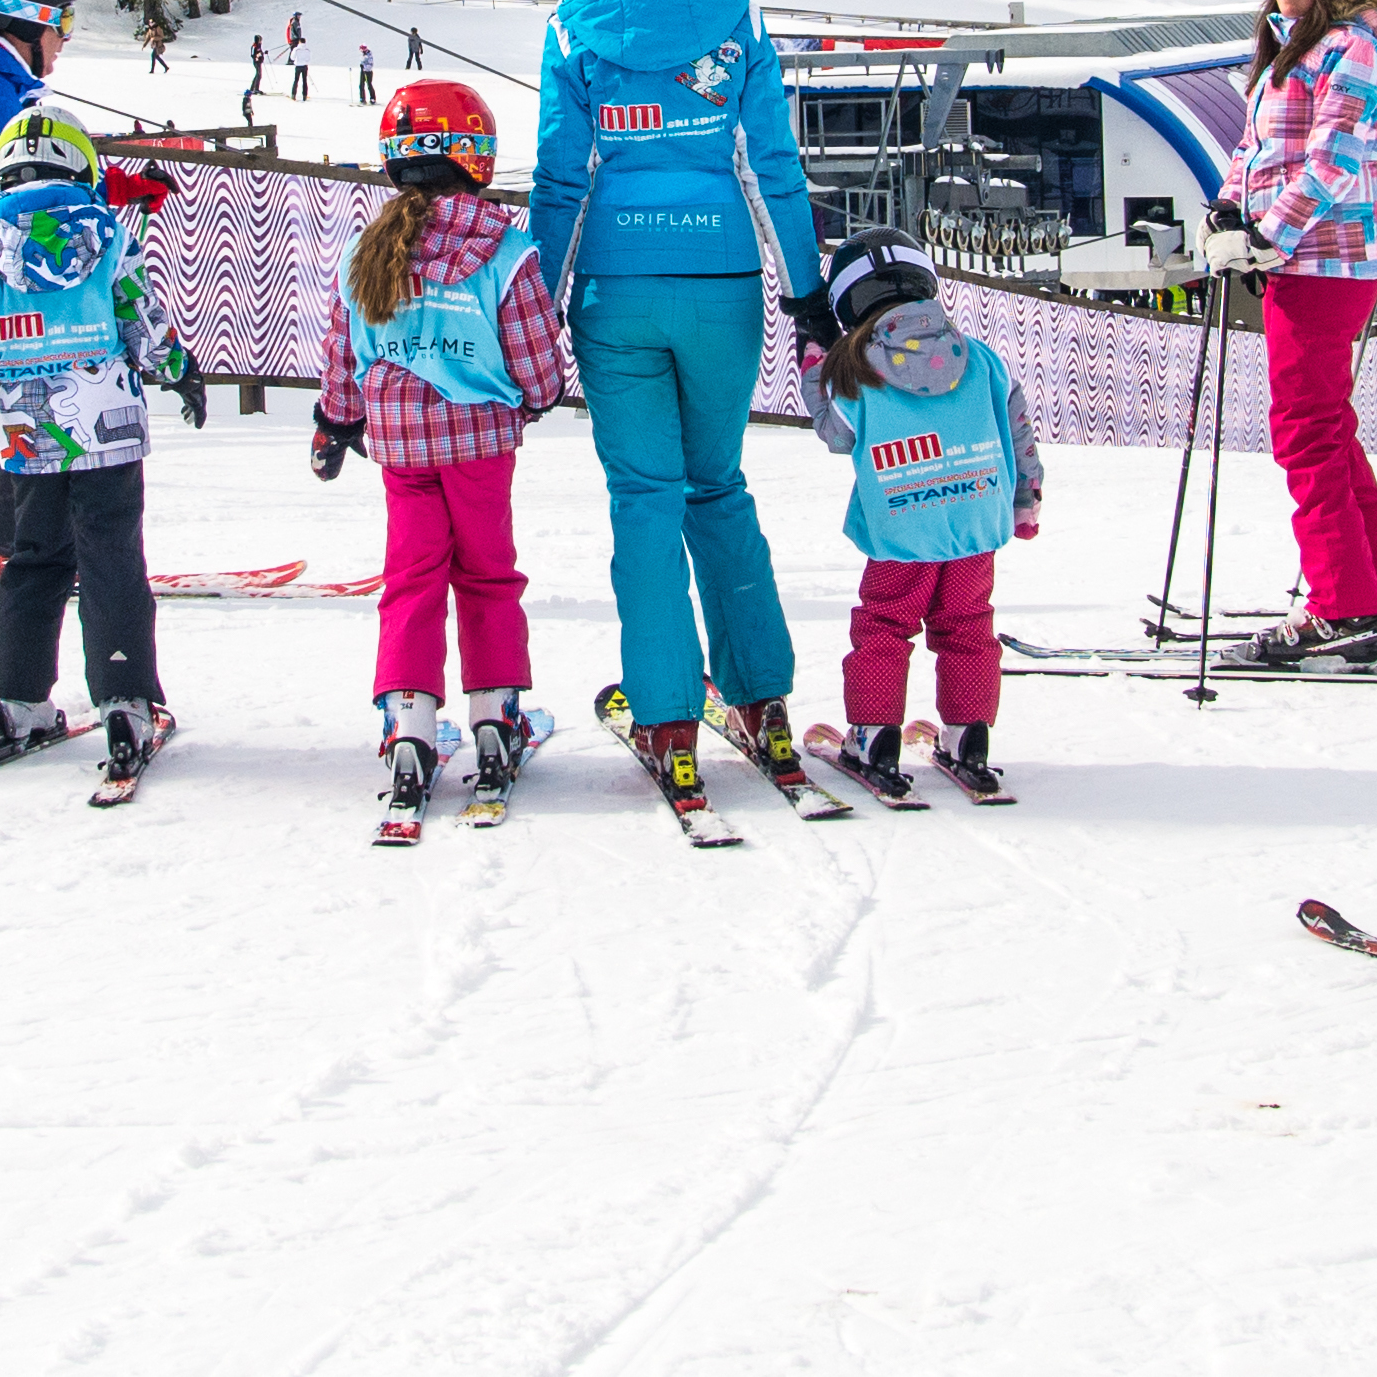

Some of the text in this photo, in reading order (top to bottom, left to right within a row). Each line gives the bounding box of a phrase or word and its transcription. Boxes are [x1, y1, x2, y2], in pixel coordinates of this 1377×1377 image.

[1330, 84, 1351, 93] OXY
[617, 213, 721, 227] ORIFLAME
[376, 336, 475, 358] ORIFLAME
[888, 475, 998, 509] STANKOV
